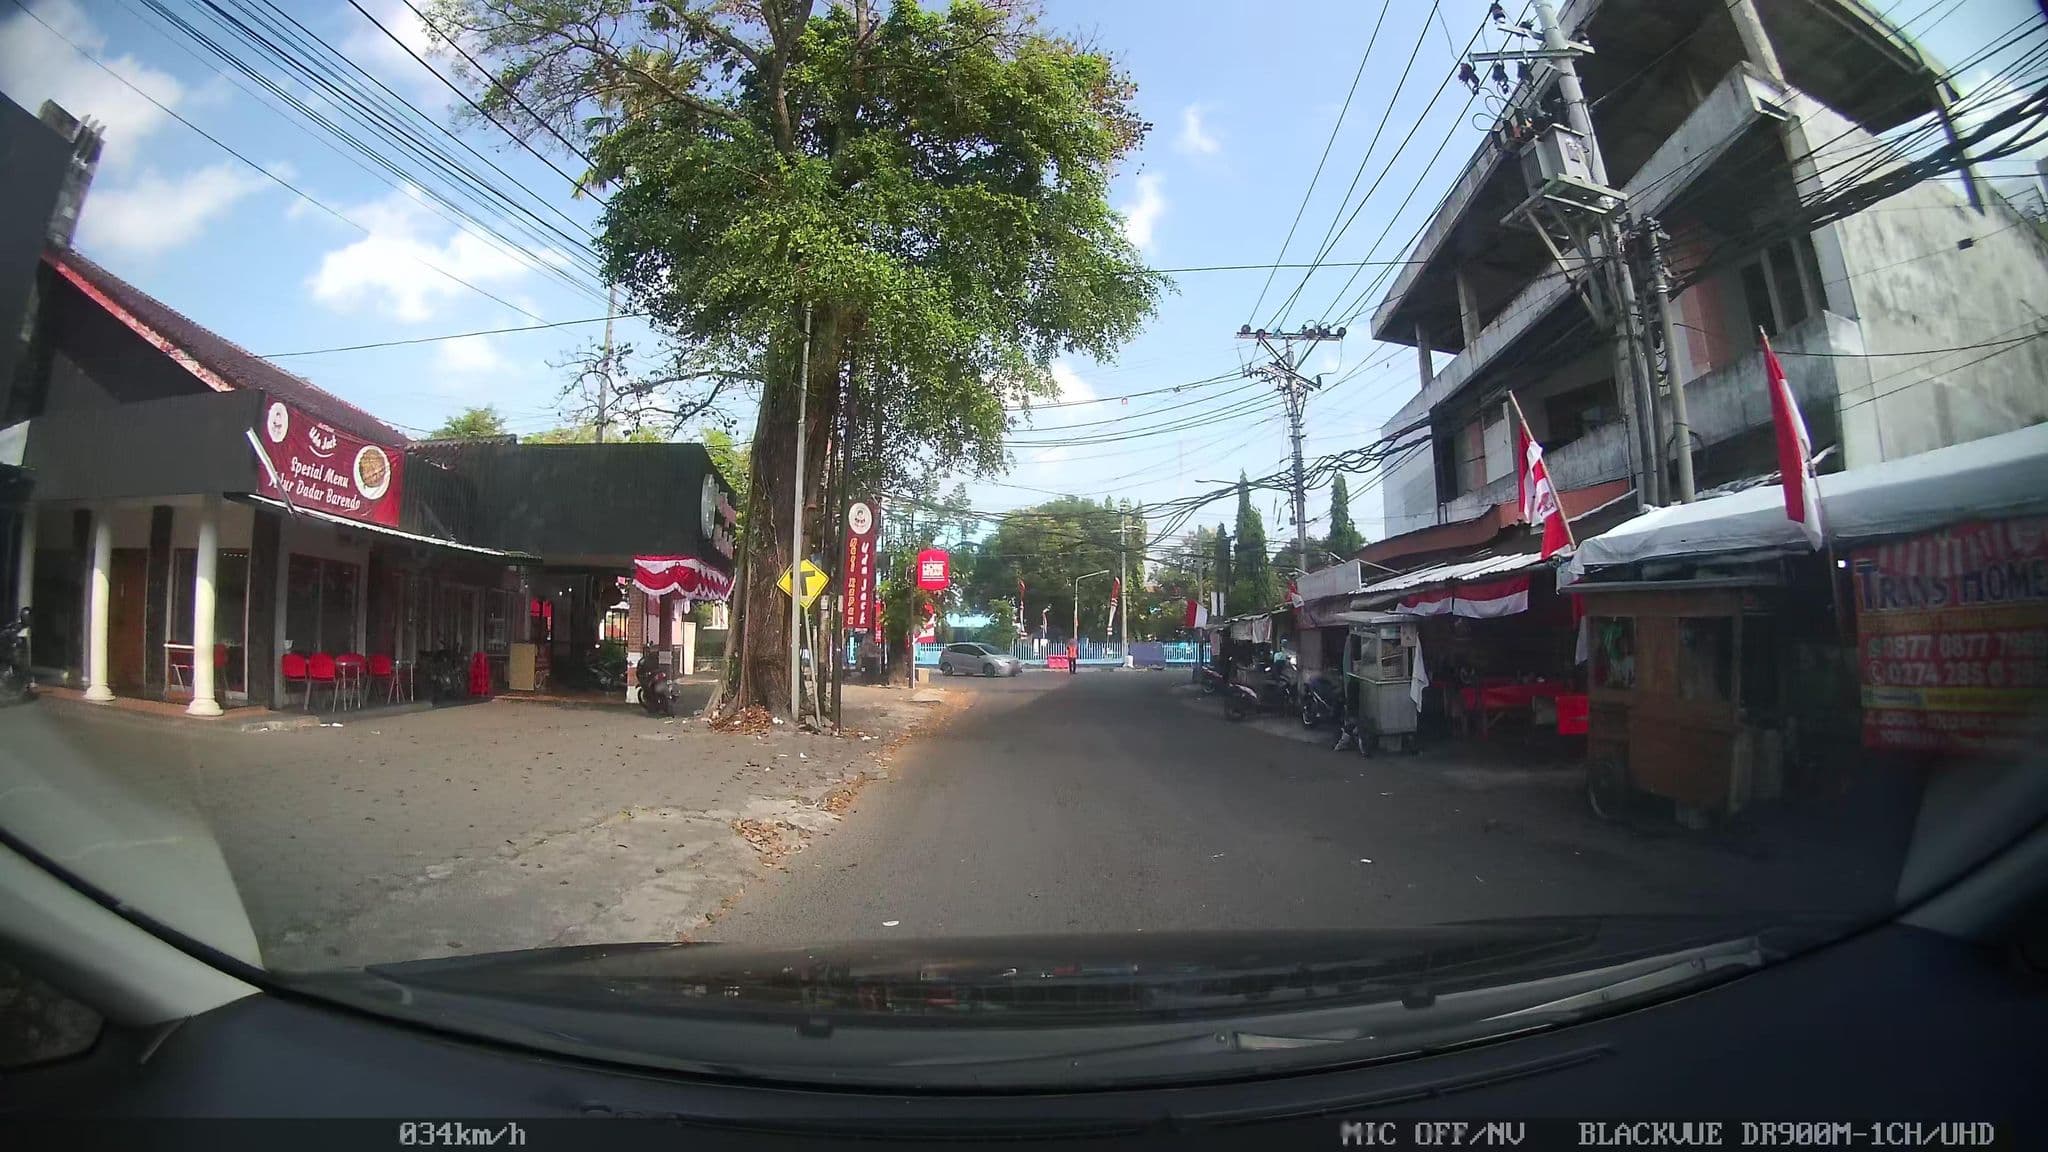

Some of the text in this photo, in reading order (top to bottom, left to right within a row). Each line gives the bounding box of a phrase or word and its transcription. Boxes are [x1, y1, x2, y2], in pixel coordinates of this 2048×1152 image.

[291, 456, 349, 488] Spesial Menu
[296, 479, 324, 500] Dadar
[326, 488, 361, 511] Barendo
[861, 541, 870, 575] Uda
[859, 578, 868, 625] Jack
